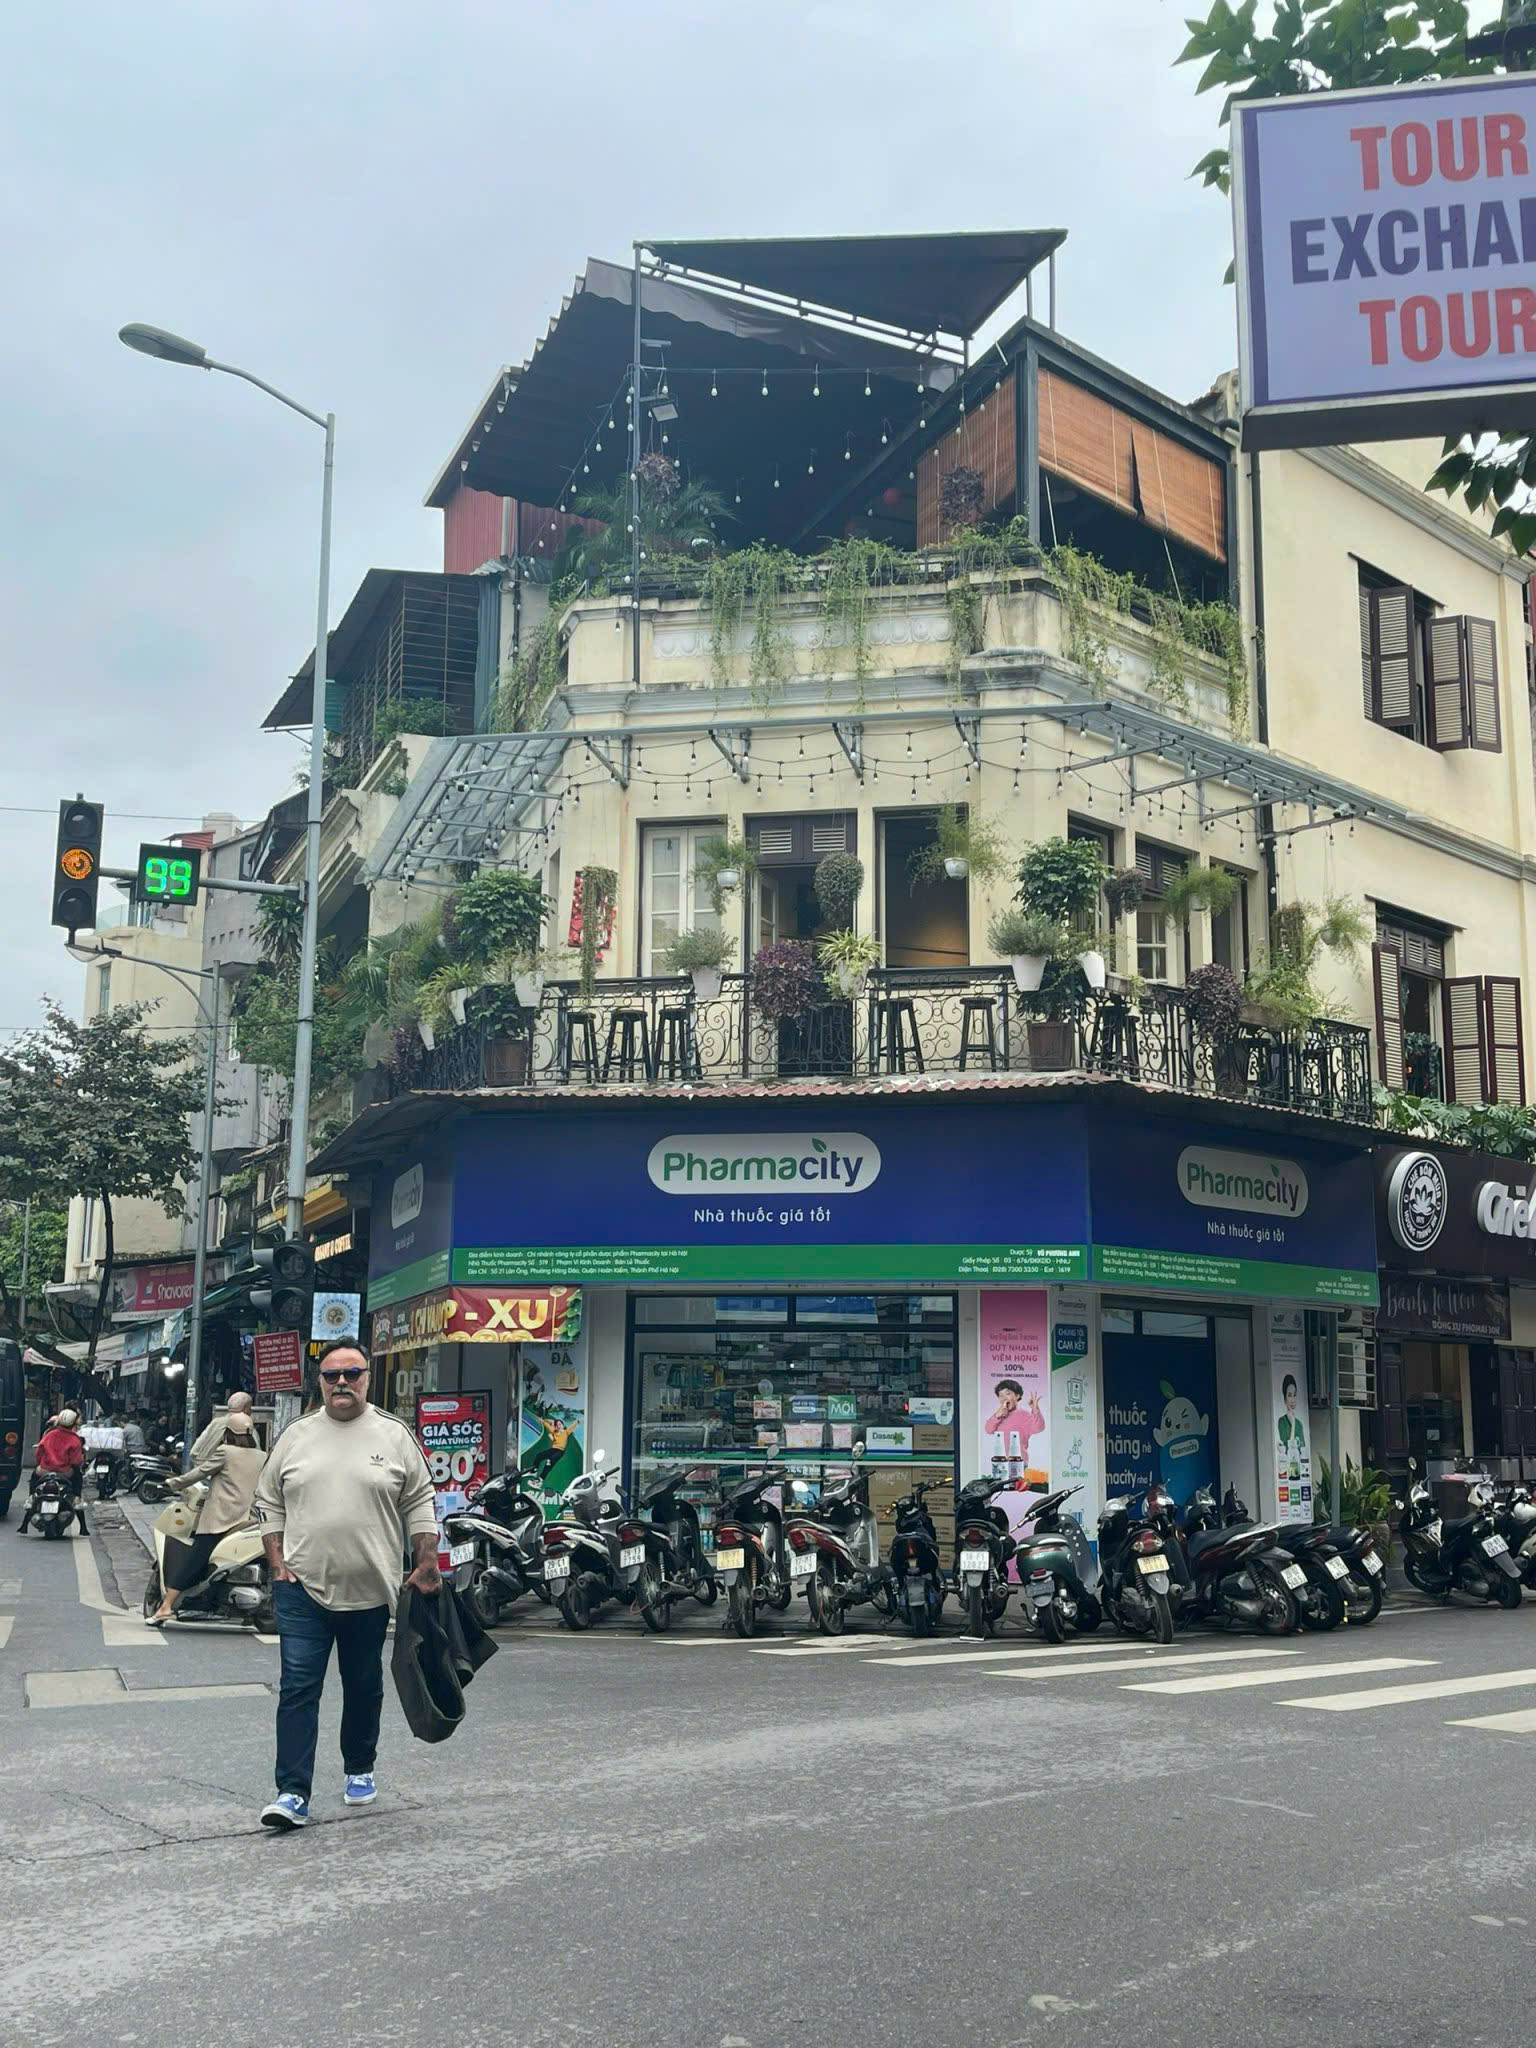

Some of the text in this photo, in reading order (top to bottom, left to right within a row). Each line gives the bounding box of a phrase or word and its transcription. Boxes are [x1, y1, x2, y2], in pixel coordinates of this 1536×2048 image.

[1350, 112, 1528, 192] TOUR
[146, 857, 191, 896] 99
[664, 1149, 863, 1187] Pharmacity
[1187, 1163, 1299, 1211] Pharmacity
[694, 1206, 831, 1225] Nhà thuốc giá tốt
[1207, 1221, 1284, 1243] Nhà thuốc giá tốt
[485, 1298, 549, 1330] XU
[1009, 1344, 1039, 1352] NHANH
[1057, 1339, 1073, 1350] CAM
[992, 1352, 1038, 1364] VIÊM HỌNG
[1004, 1364, 1024, 1372] 100%
[830, 1399, 854, 1414] MỚI
[1109, 1402, 1147, 1427] thuốc
[422, 1419, 482, 1438] GIÁ SỐC
[424, 1436, 483, 1447] CHƯA TỪNG CÓ
[1106, 1434, 1140, 1460] hãng
